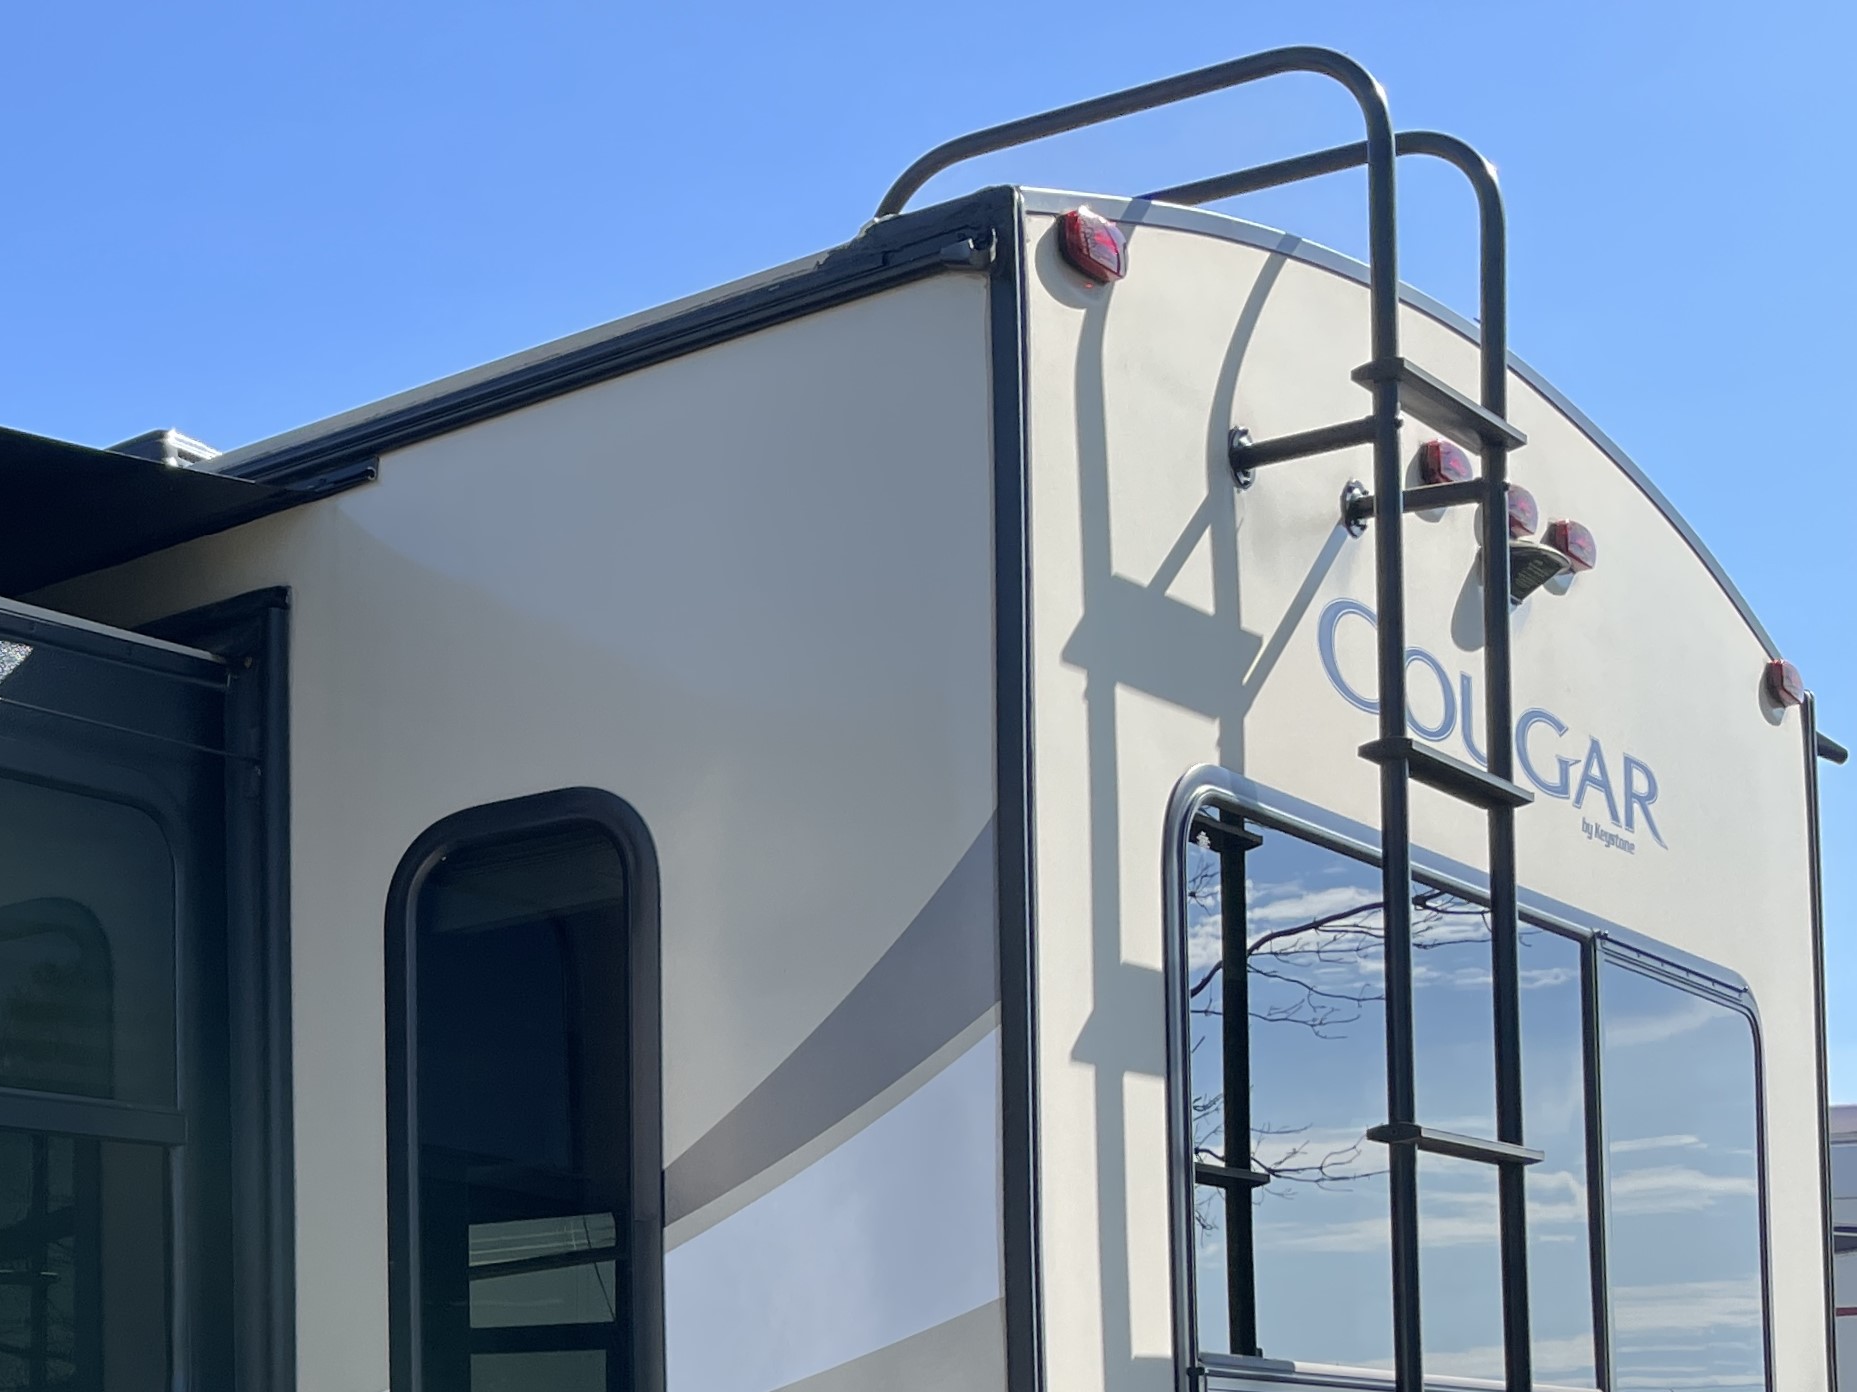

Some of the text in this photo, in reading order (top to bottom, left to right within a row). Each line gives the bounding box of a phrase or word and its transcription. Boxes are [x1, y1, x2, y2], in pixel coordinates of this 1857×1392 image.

[1317, 597, 1668, 851] COUGAR
[1581, 816, 1636, 855] by Keystone
